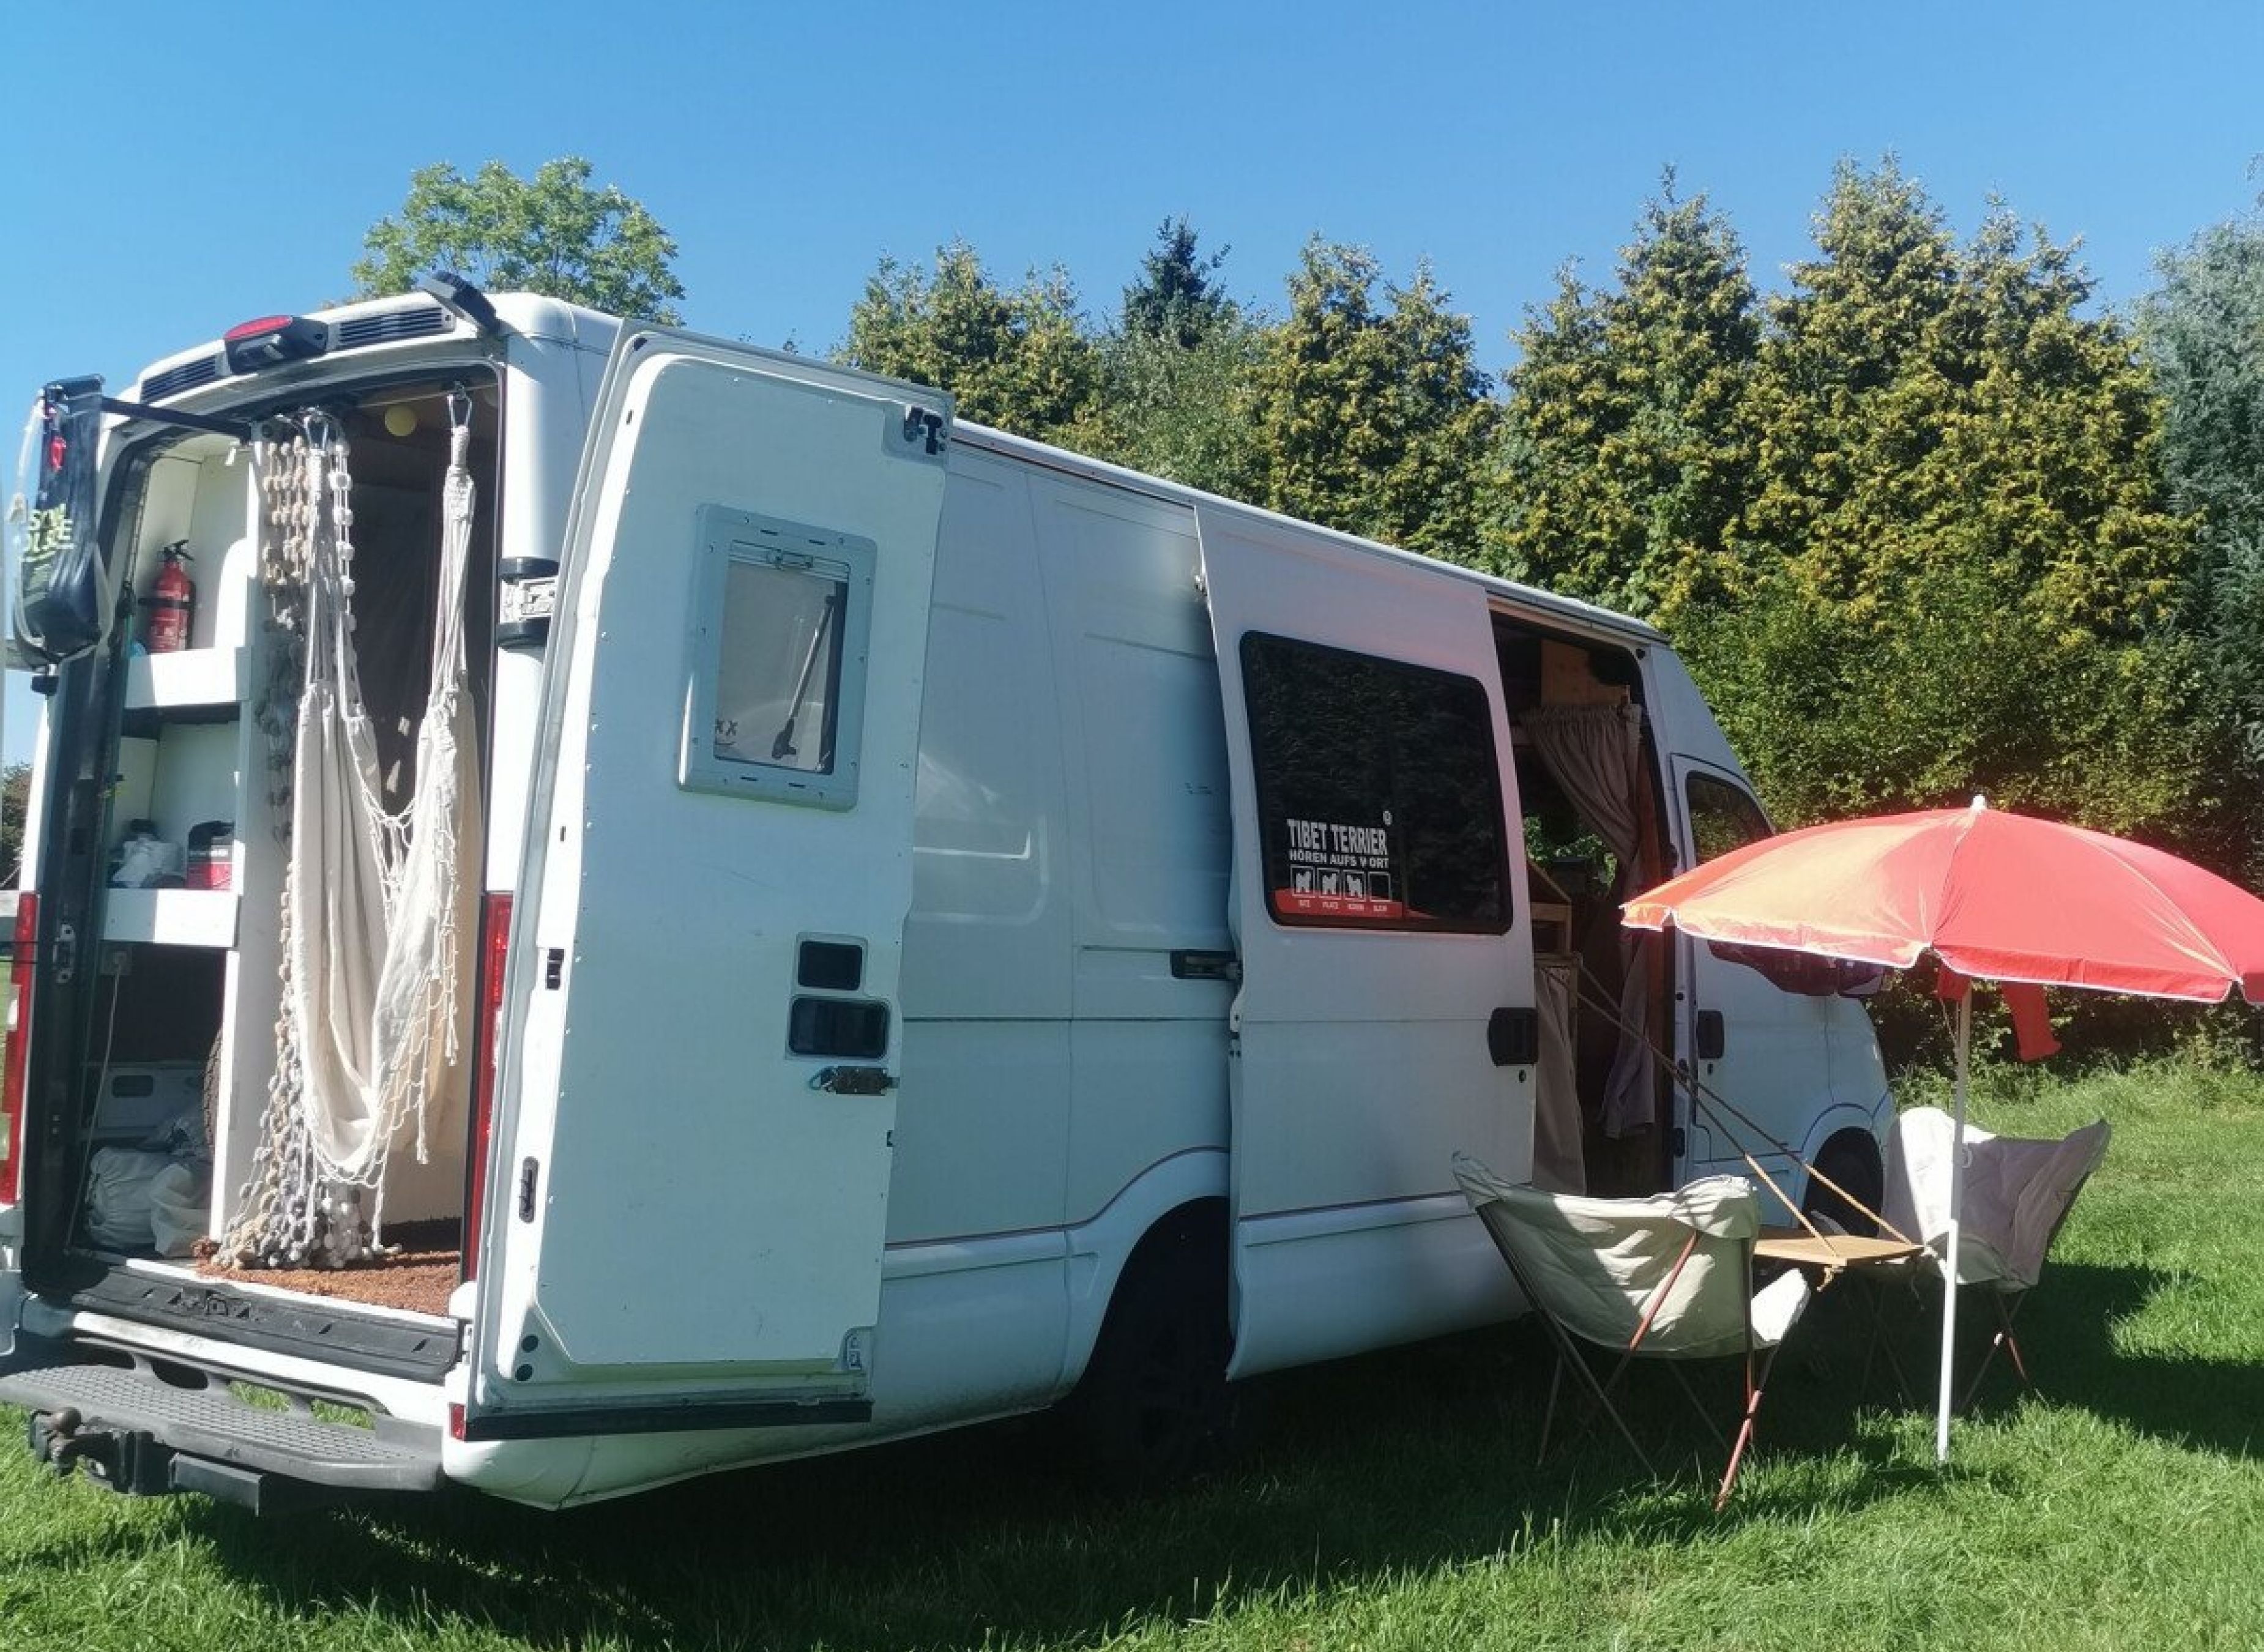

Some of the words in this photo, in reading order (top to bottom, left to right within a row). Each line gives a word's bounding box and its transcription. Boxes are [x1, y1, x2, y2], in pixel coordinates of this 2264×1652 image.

[1286, 818, 1327, 850] TIBET
[1330, 824, 1388, 855] TERRIER
[1330, 854, 1357, 866] AUFS
